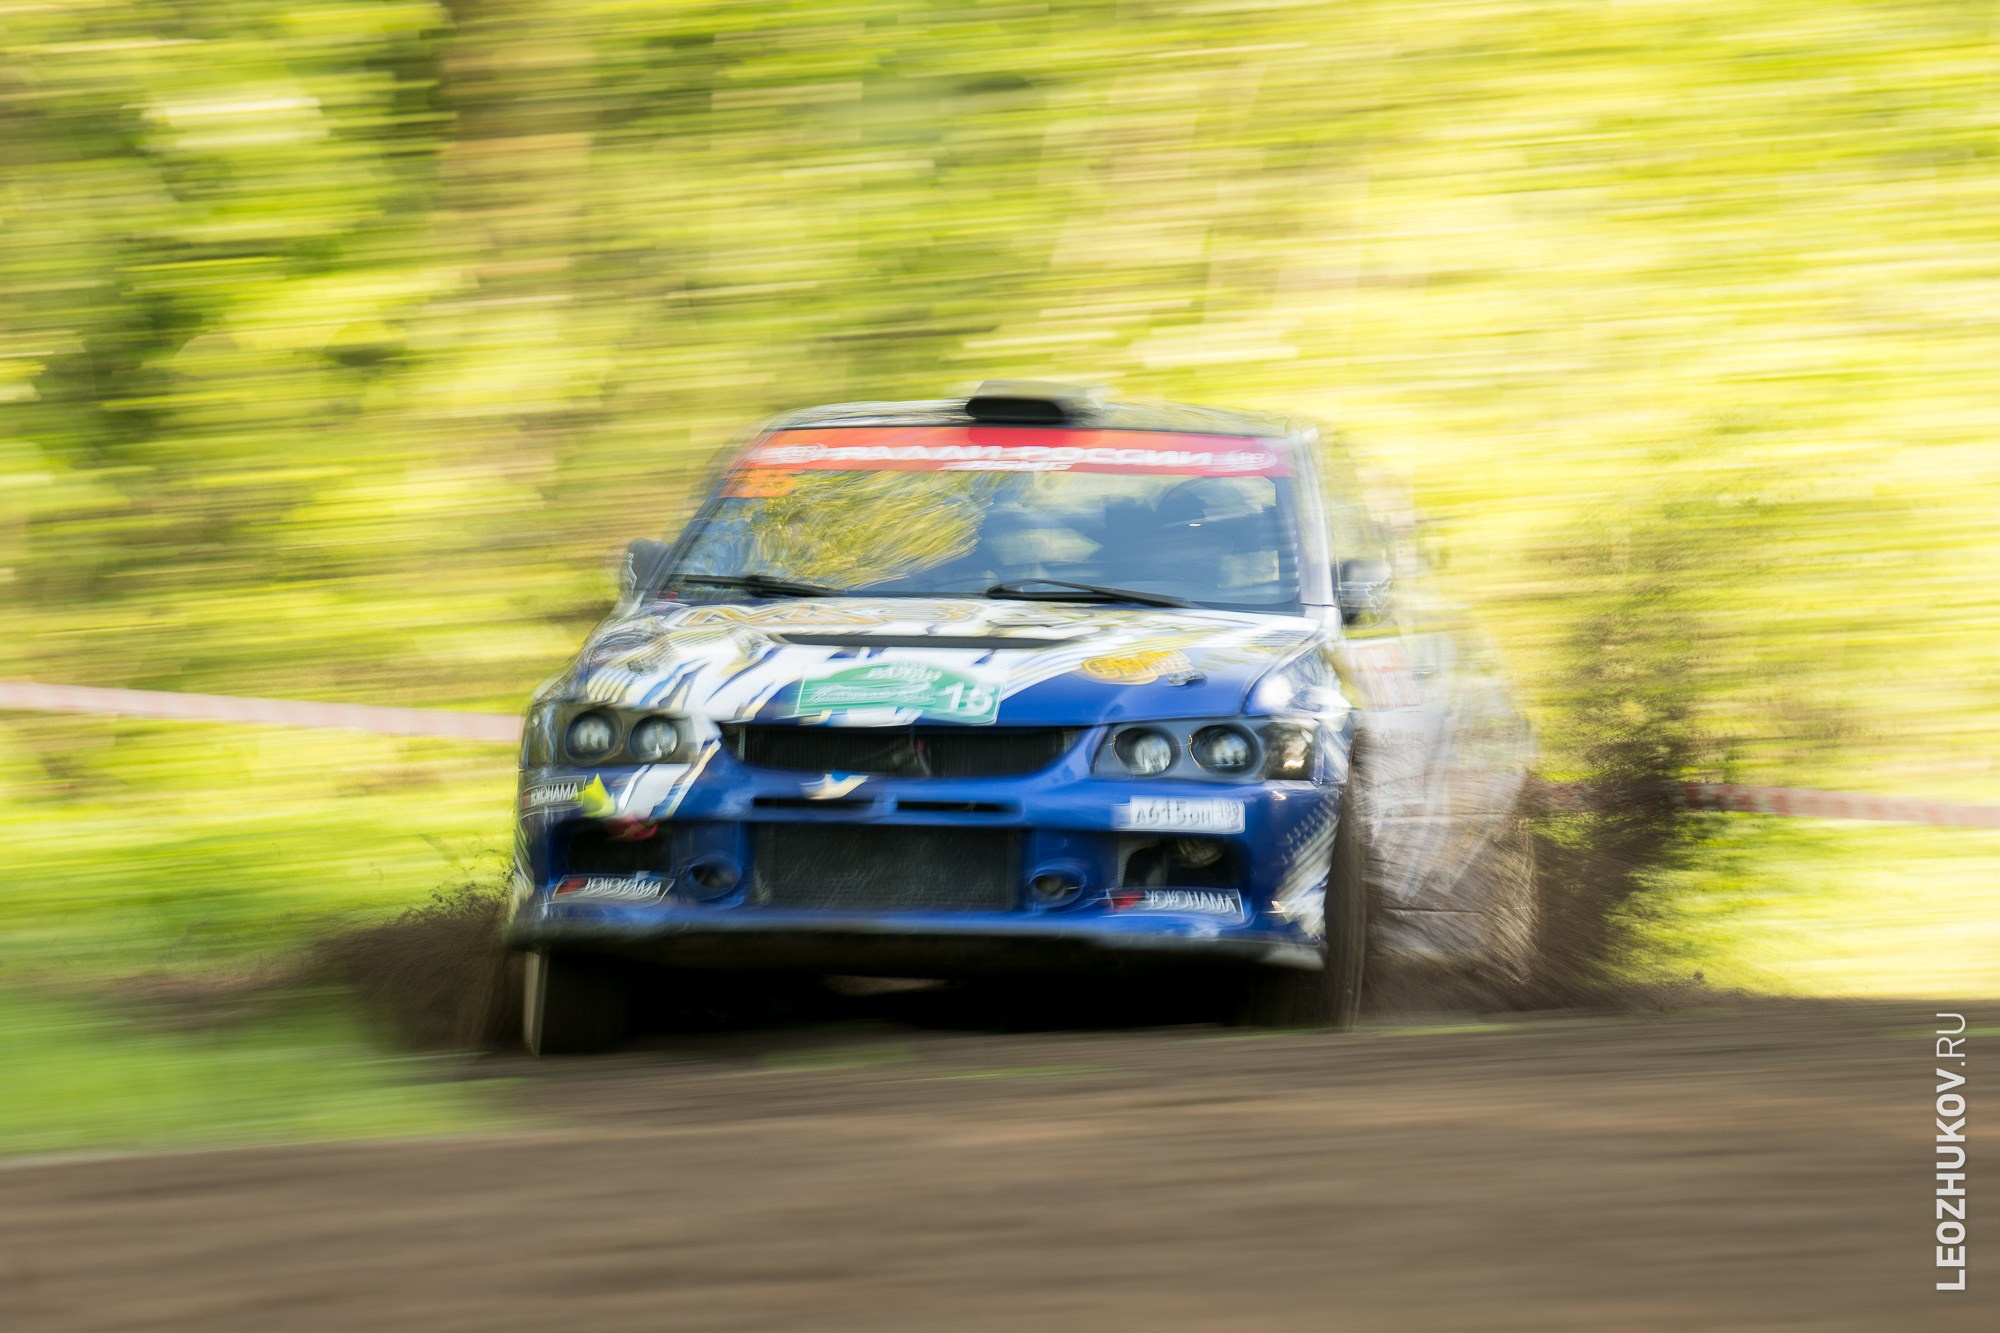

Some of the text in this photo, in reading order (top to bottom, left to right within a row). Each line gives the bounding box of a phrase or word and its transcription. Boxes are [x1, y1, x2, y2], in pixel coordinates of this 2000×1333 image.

[530, 782, 580, 805] YOKOHAMA
[584, 877, 662, 897] YOKOHAMA
[1145, 889, 1237, 913] YOKOHAMA
